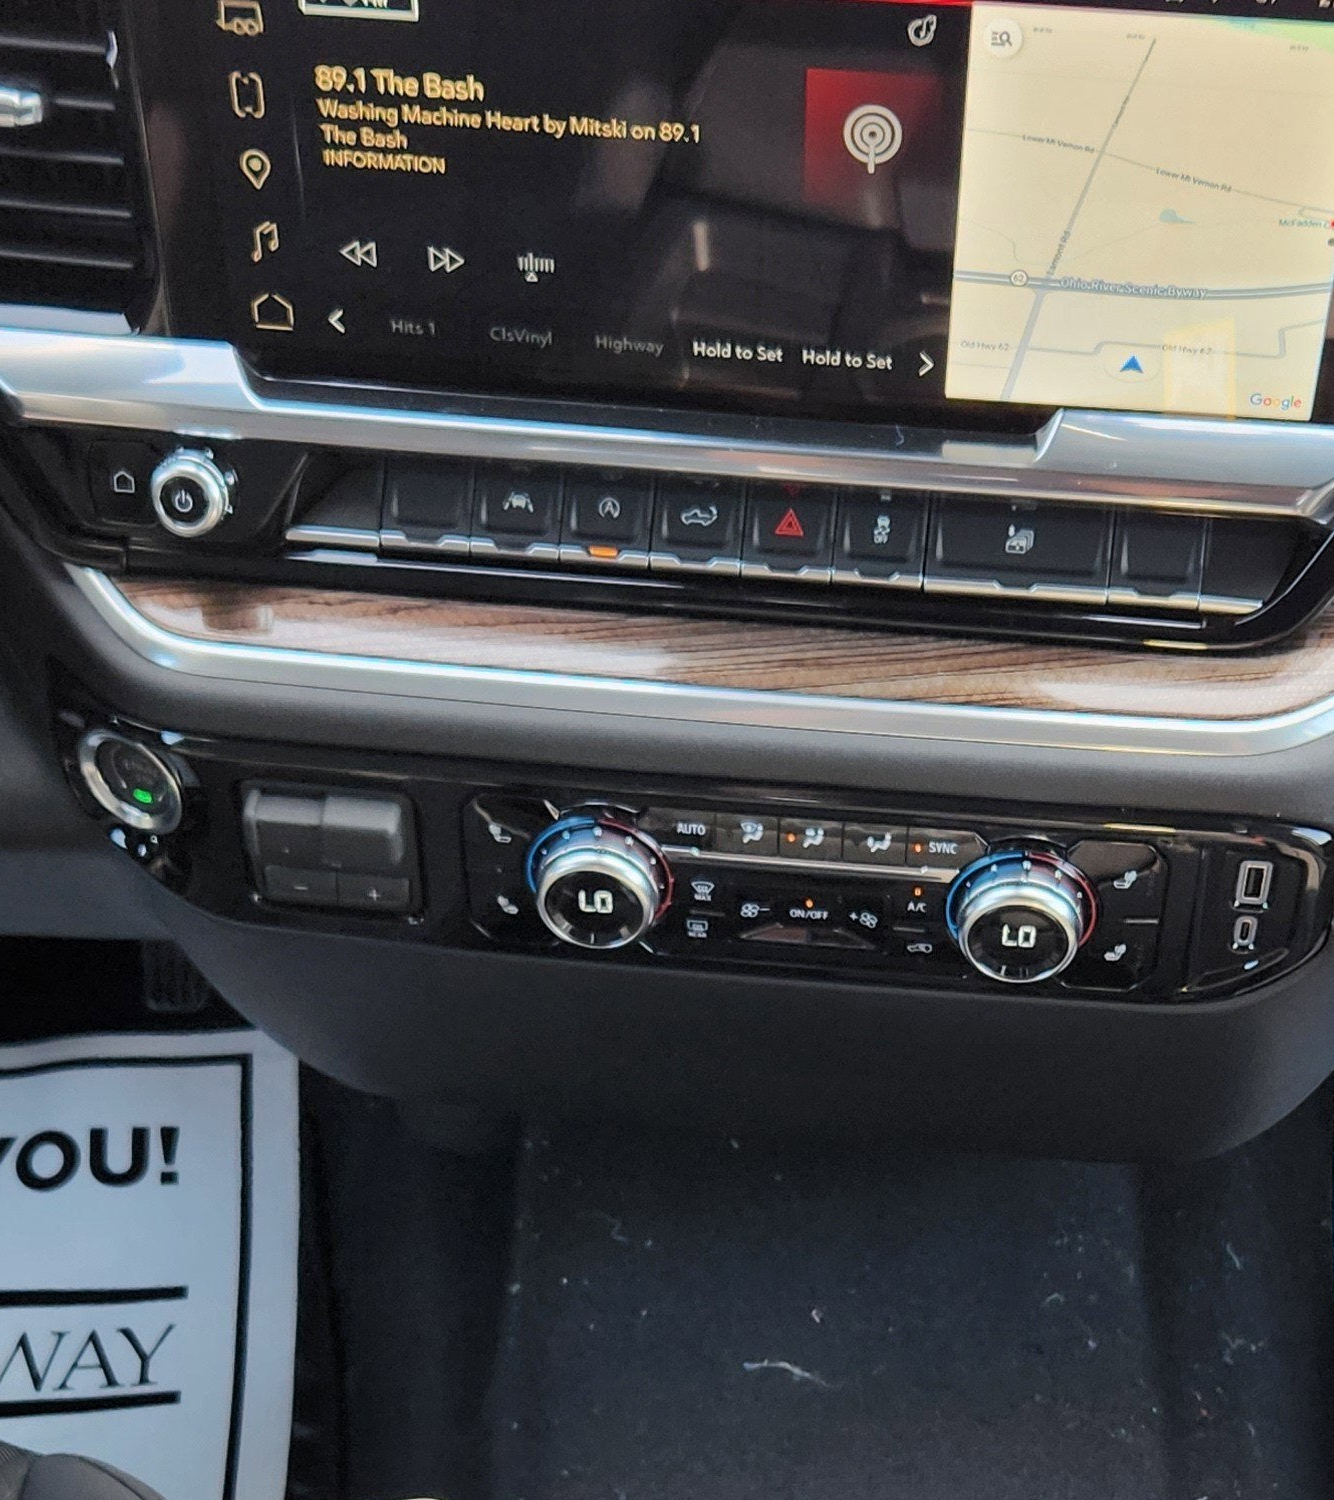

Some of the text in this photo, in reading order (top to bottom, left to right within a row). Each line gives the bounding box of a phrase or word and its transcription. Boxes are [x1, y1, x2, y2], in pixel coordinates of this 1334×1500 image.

[314, 64, 484, 101] 89.1 The Bash
[316, 97, 700, 144] Washing Machine Heart by Mitski on 89.1
[319, 122, 408, 150] The Bash
[322, 148, 446, 174] INFORMATION
[1156, 167, 1179, 180] Lower
[1192, 177, 1219, 190] Vernon
[1014, 274, 1025, 283] 62
[1060, 276, 1207, 300] Ohio River Scenic Byway
[389, 319, 437, 337] Hits 1
[596, 335, 664, 358] Highway
[692, 340, 783, 362] Hold to Set
[802, 349, 893, 370] Hold to Set
[1250, 392, 1302, 411] Google
[677, 821, 706, 836] AUTO
[929, 841, 957, 855] SYNC
[789, 908, 828, 920] ON/OFF
[907, 900, 927, 913] A/C
